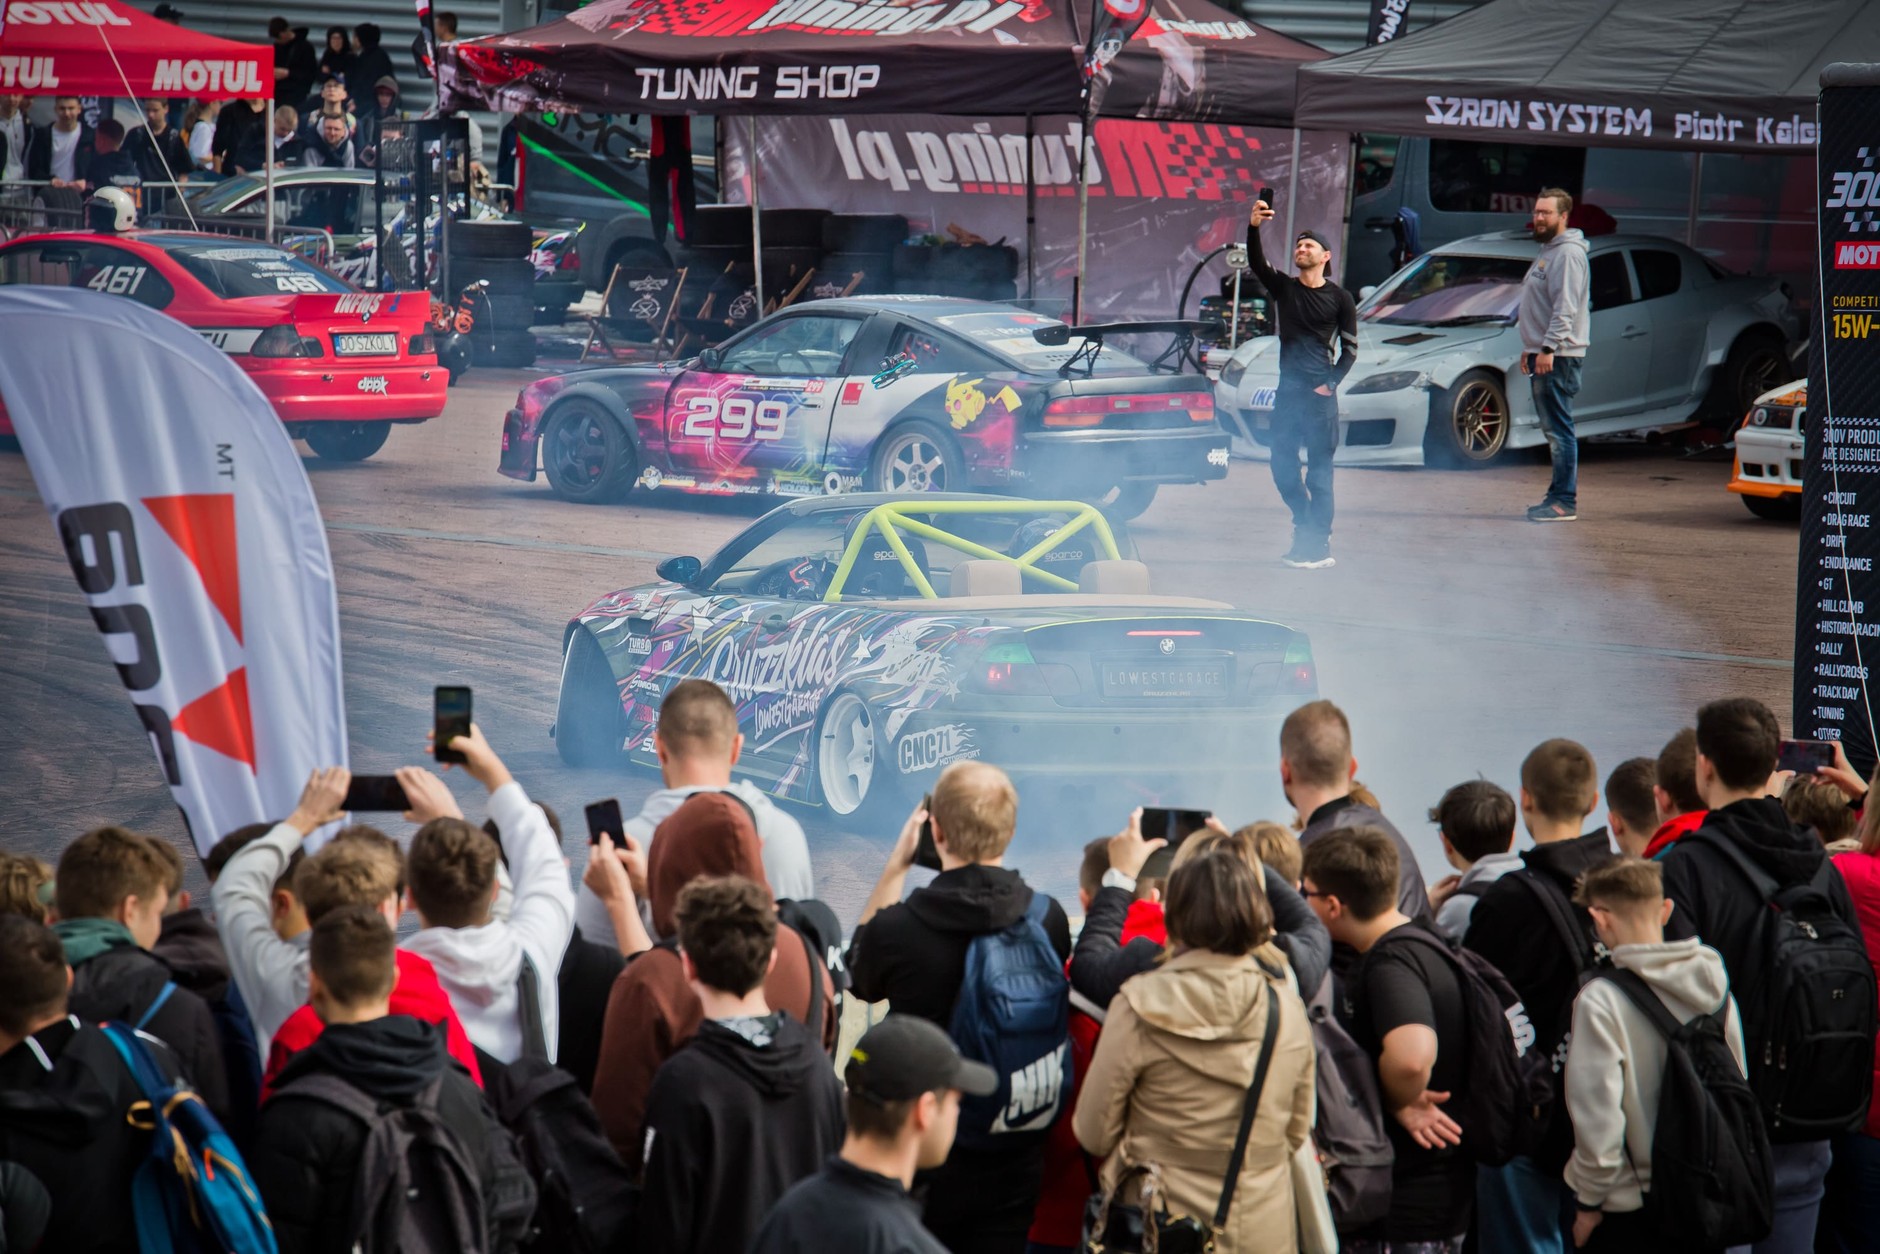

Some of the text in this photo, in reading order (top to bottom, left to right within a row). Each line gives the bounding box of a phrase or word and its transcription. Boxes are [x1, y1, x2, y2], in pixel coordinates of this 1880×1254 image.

[6, 1, 132, 26] OTUL
[0, 55, 60, 89] TUL
[152, 59, 263, 92] MOTUL
[635, 64, 881, 100] TUNING SHOP
[1425, 95, 1521, 129] SZRON
[1526, 101, 1653, 138] SYSTEM
[1675, 111, 1744, 142] Piotr
[87, 265, 148, 295] 461
[276, 277, 328, 293] 461
[334, 293, 384, 314] INFMS
[340, 334, 396, 351] DO SZKOLY
[805, 380, 824, 393] 299
[683, 396, 788, 440] 299
[1823, 428, 1847, 444] 300V
[216, 443, 235, 480] MT
[1822, 447, 1838, 461] ARE
[1828, 492, 1857, 505] CIRCUIT
[1827, 513, 1870, 528] DRAG RACE
[1826, 535, 1847, 548] DRIFT
[873, 550, 914, 561] spao
[1824, 556, 1872, 571] ENDURANCE
[1823, 577, 1834, 590] GT
[1822, 599, 1838, 612] HILL
[1821, 621, 1855, 635] HISTORIC
[1820, 642, 1843, 656] RALLY
[1818, 663, 1869, 680] RALLYCROSS
[1817, 706, 1845, 720] TUNING
[1817, 727, 1841, 741] OTHER
[900, 729, 951, 771] CNC71
